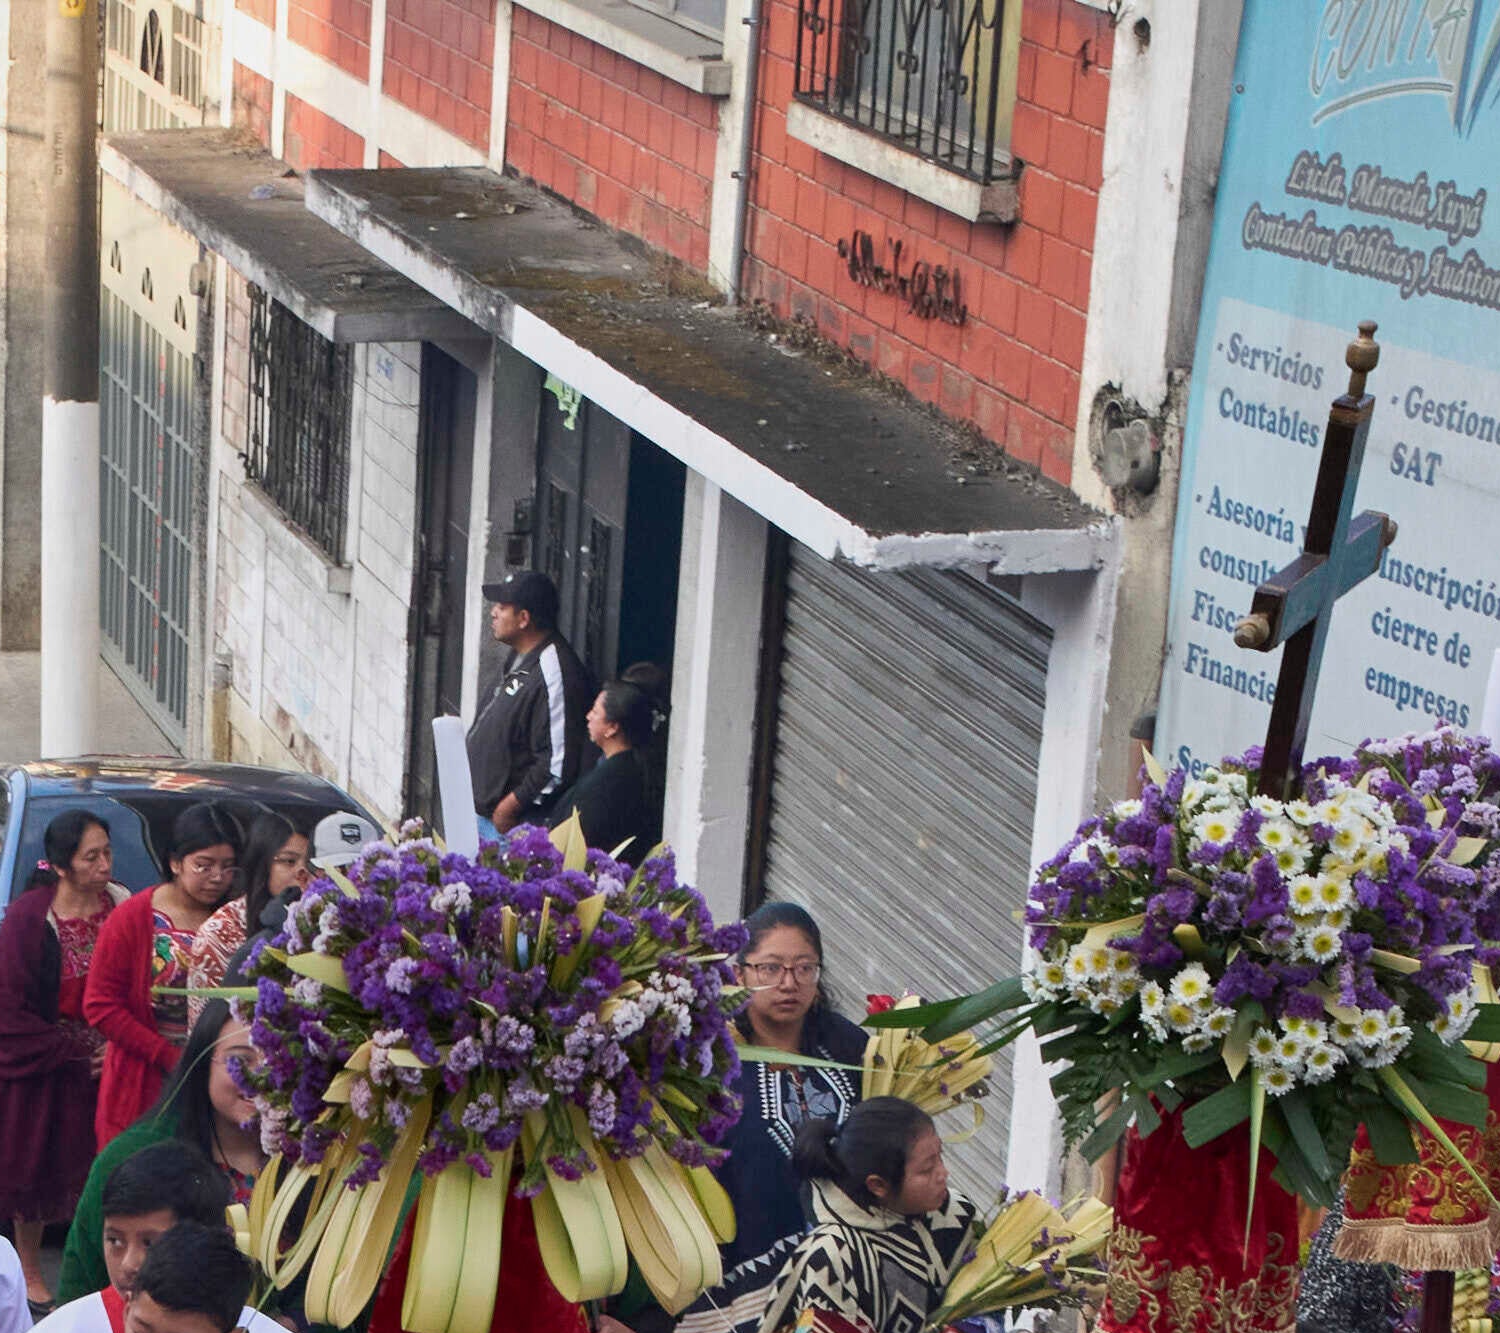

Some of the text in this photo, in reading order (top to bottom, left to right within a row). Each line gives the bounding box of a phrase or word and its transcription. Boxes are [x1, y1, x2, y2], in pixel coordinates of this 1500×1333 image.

[1349, 165, 1430, 226] Marcela
[1243, 203, 1334, 264] Contadora
[1333, 225, 1408, 284] Pública
[1227, 332, 1324, 390] Servicios
[1219, 387, 1320, 448] Contables
[1390, 441, 1442, 487] SAT
[1207, 486, 1294, 544] Asesoría
[1370, 608, 1471, 669] cierre de
[1365, 665, 1470, 729] empresas
